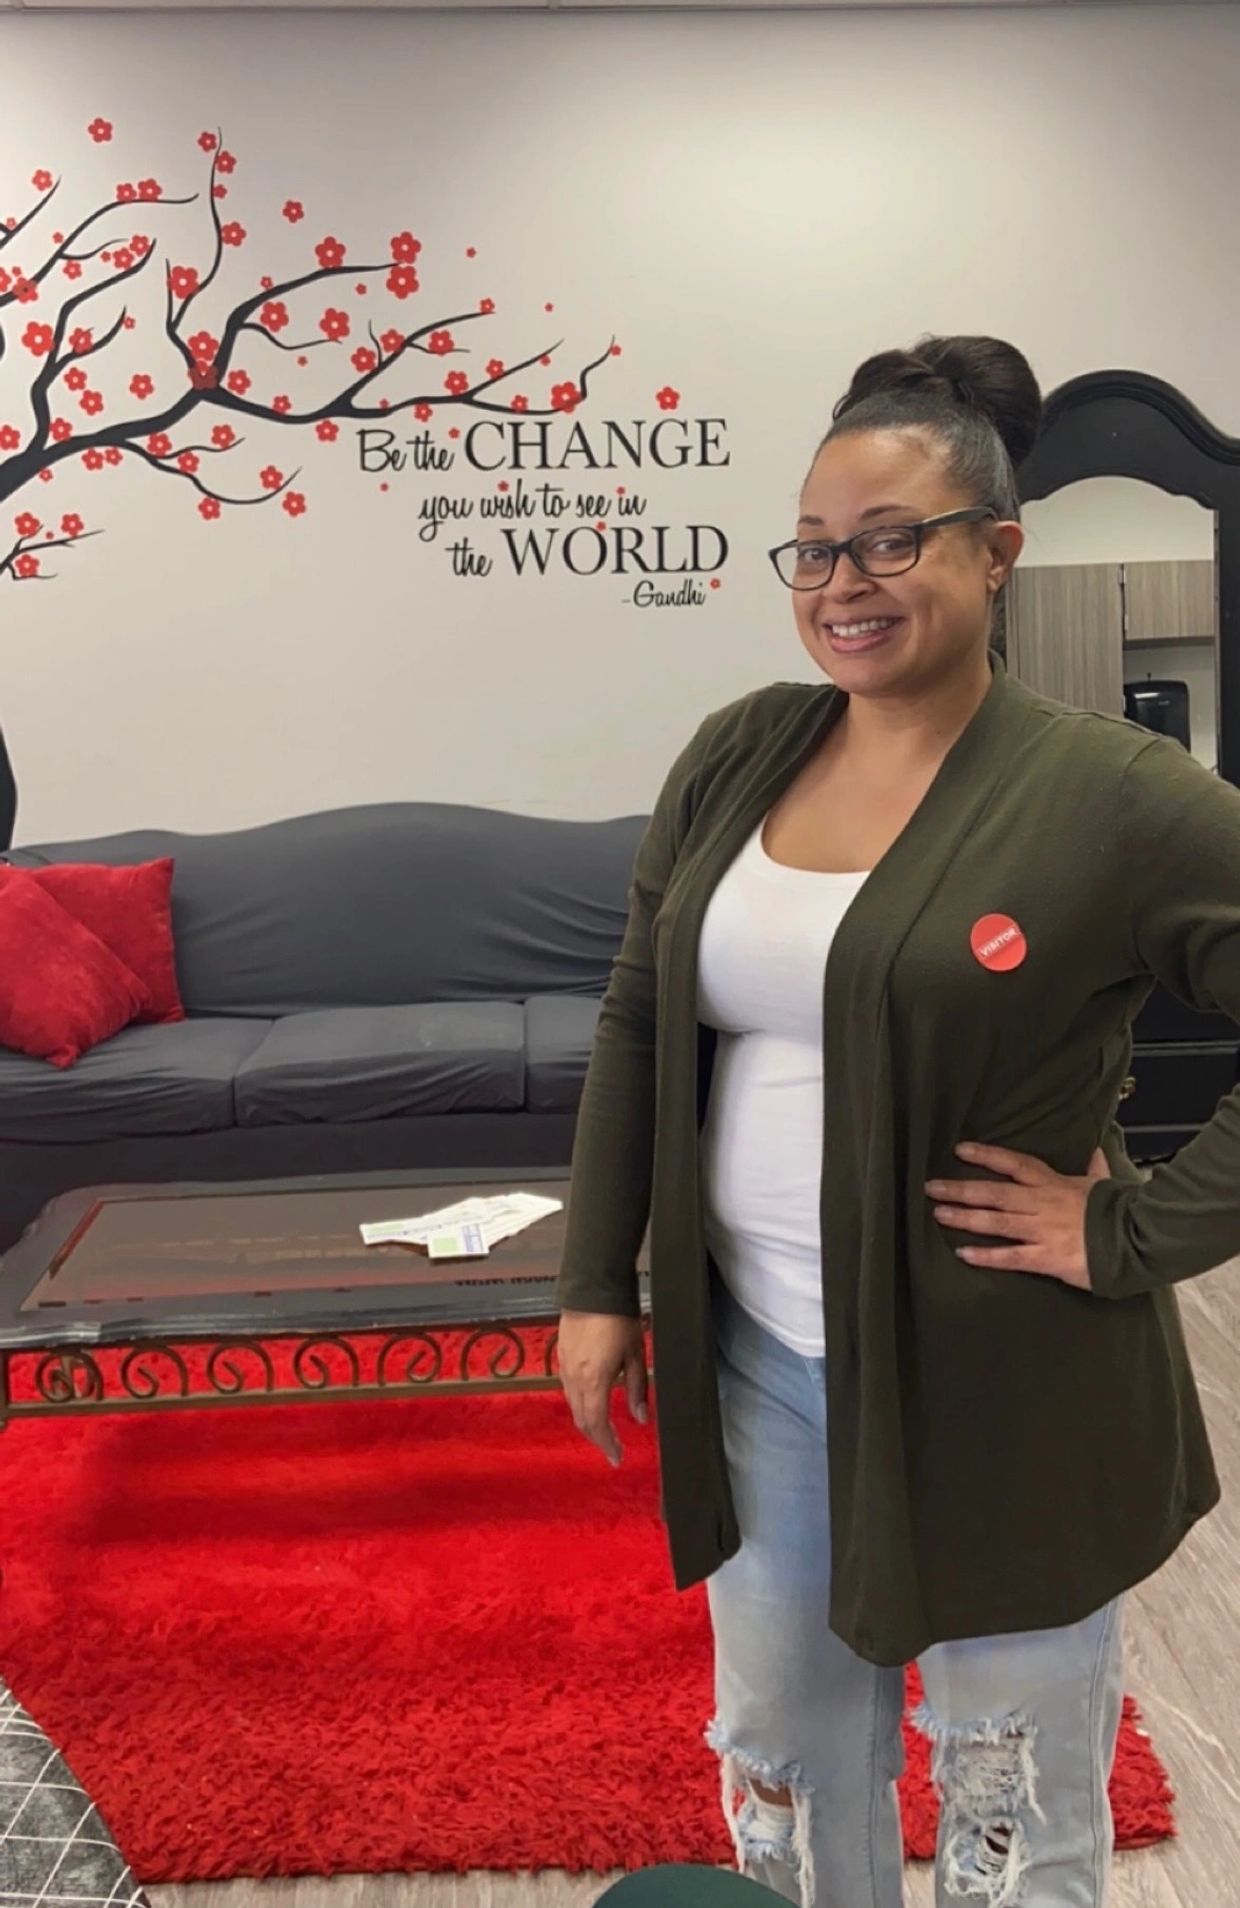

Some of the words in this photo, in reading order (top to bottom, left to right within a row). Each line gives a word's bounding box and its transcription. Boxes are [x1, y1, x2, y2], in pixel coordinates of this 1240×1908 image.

[356, 429, 406, 472] Be
[406, 430, 455, 472] the
[465, 418, 731, 471] CHANGE
[418, 494, 474, 542] you
[480, 478, 536, 519] wish
[535, 483, 571, 518] to
[576, 493, 613, 518] see
[617, 486, 648, 517] in
[445, 537, 493, 577] the
[501, 524, 730, 576] WORLD
